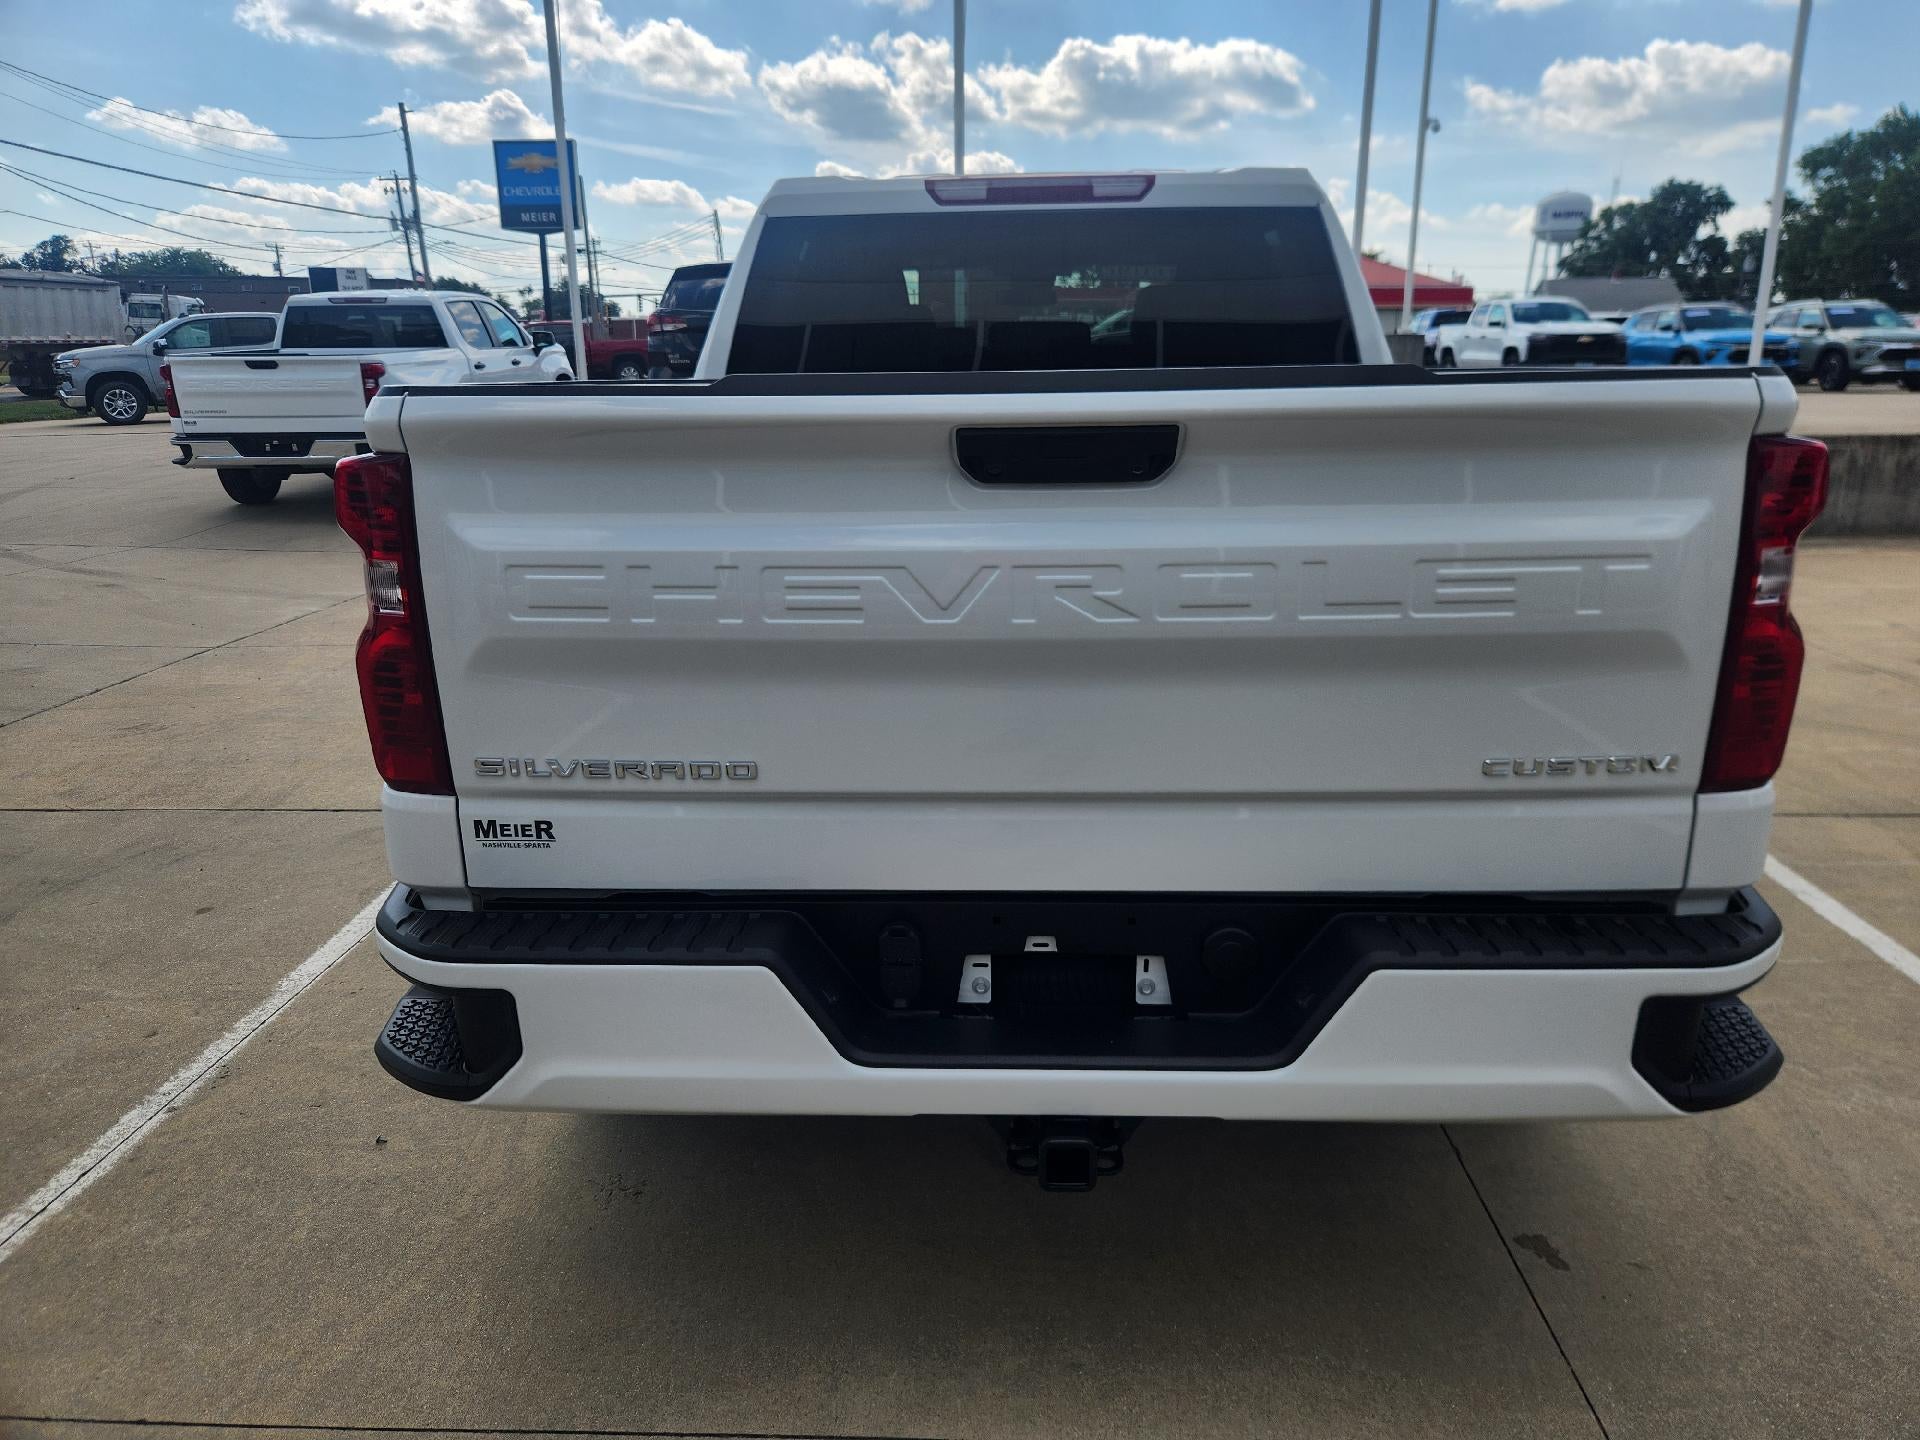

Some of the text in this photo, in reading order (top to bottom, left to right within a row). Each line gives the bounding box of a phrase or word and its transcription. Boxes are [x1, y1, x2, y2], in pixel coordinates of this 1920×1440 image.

[503, 186, 560, 197] CHEVROLE
[521, 212, 557, 223] MEIER
[504, 554, 1652, 623] CHEVROLET
[474, 757, 758, 780] SILVERADO
[1482, 754, 1680, 776] CUSTOM
